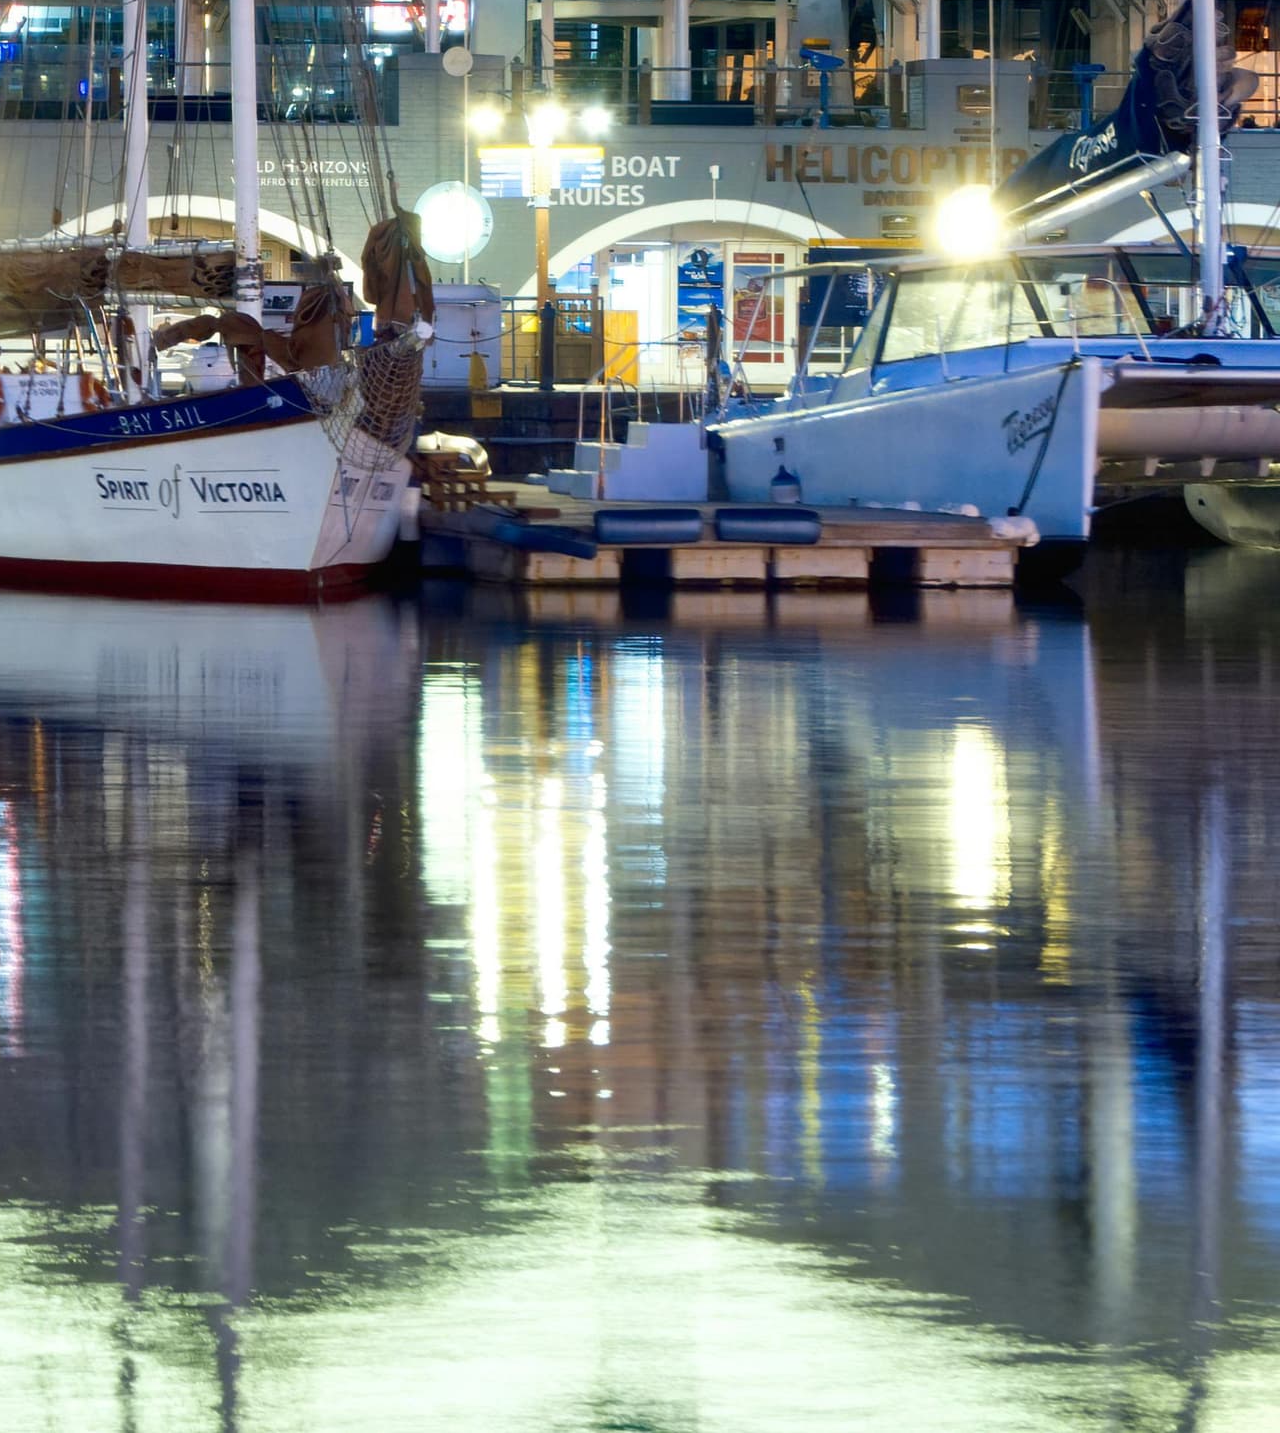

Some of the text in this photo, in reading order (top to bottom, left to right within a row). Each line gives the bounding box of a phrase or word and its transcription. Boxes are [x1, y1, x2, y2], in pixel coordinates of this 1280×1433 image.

[281, 158, 370, 174] HORIZONS
[611, 156, 681, 178] BOAT
[118, 406, 207, 435] BAY SAIL
[95, 463, 287, 519] SPIRIT of VICTORIA
